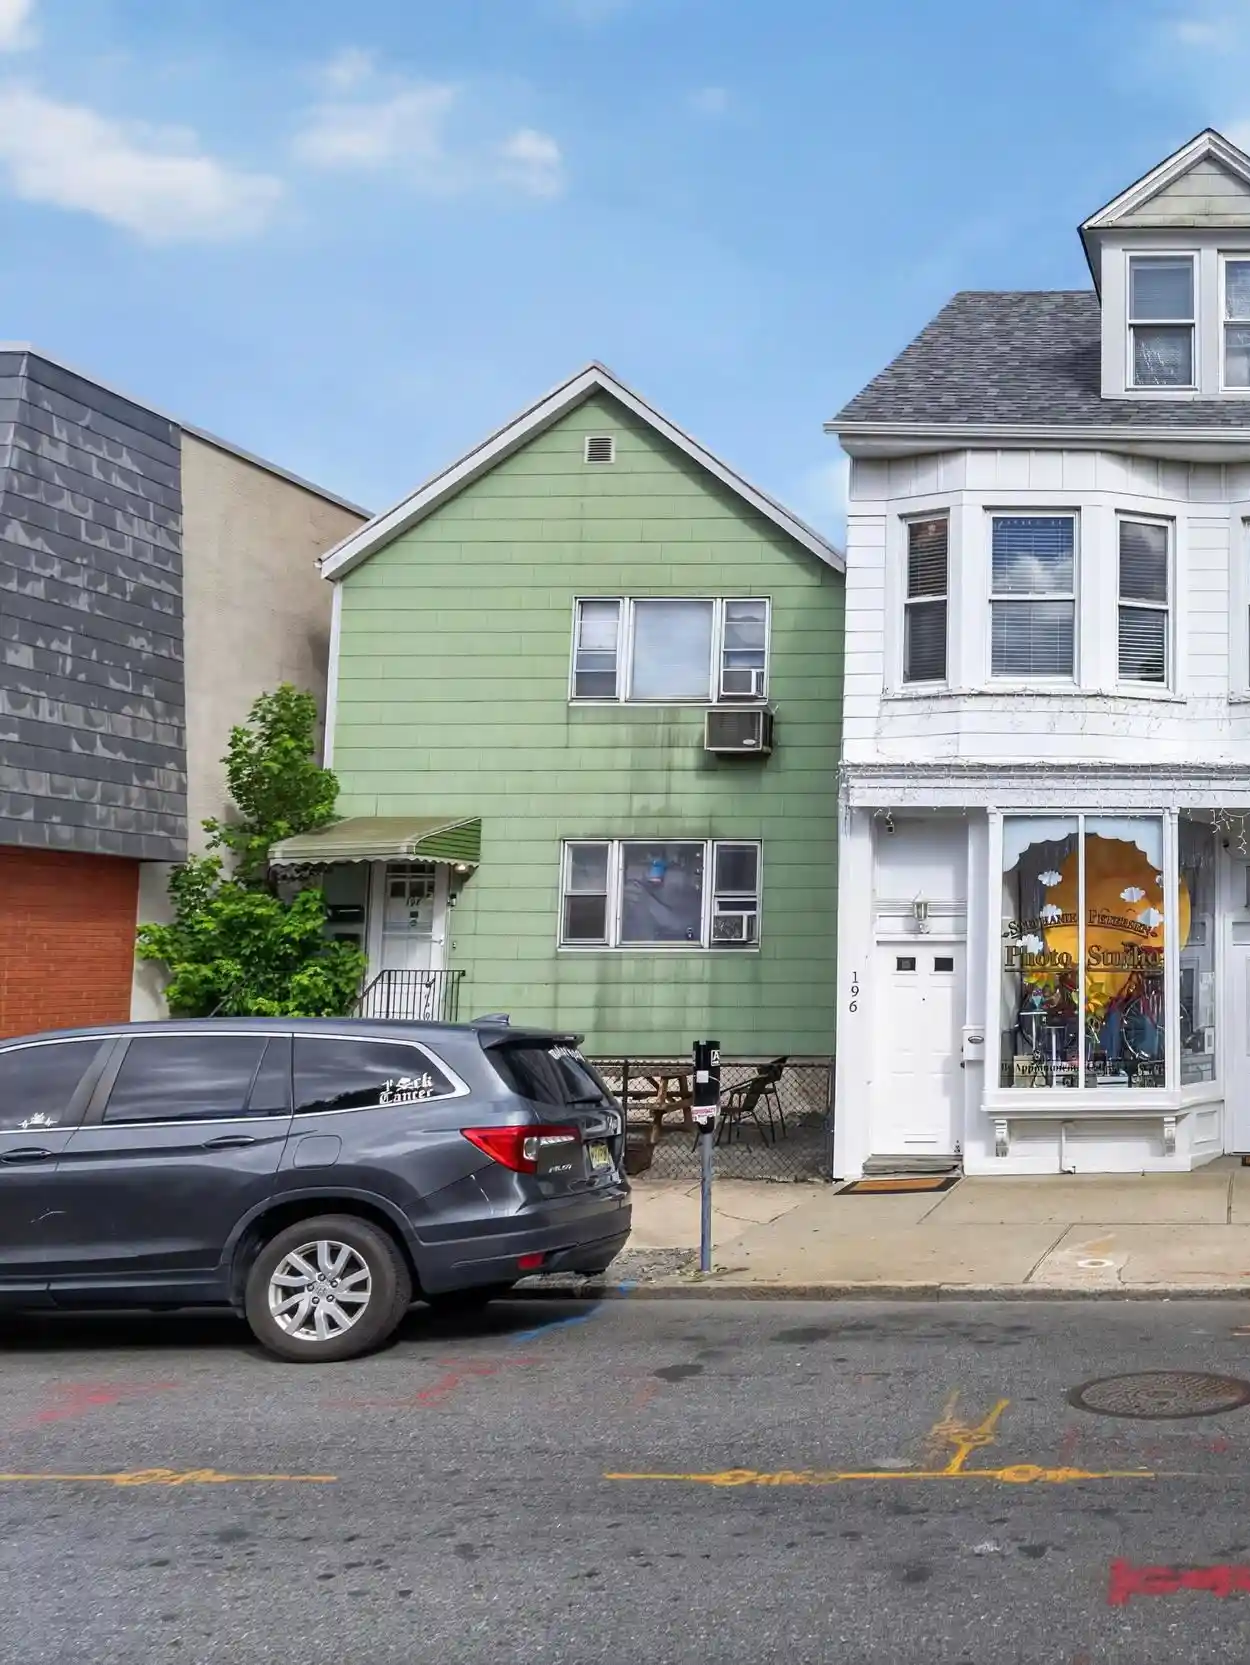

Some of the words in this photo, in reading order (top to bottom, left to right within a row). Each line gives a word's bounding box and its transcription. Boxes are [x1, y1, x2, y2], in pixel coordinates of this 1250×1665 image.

[1004, 945, 1073, 967] Photo
[1087, 942, 1161, 968] Studio
[379, 1088, 434, 1105] Cancer
